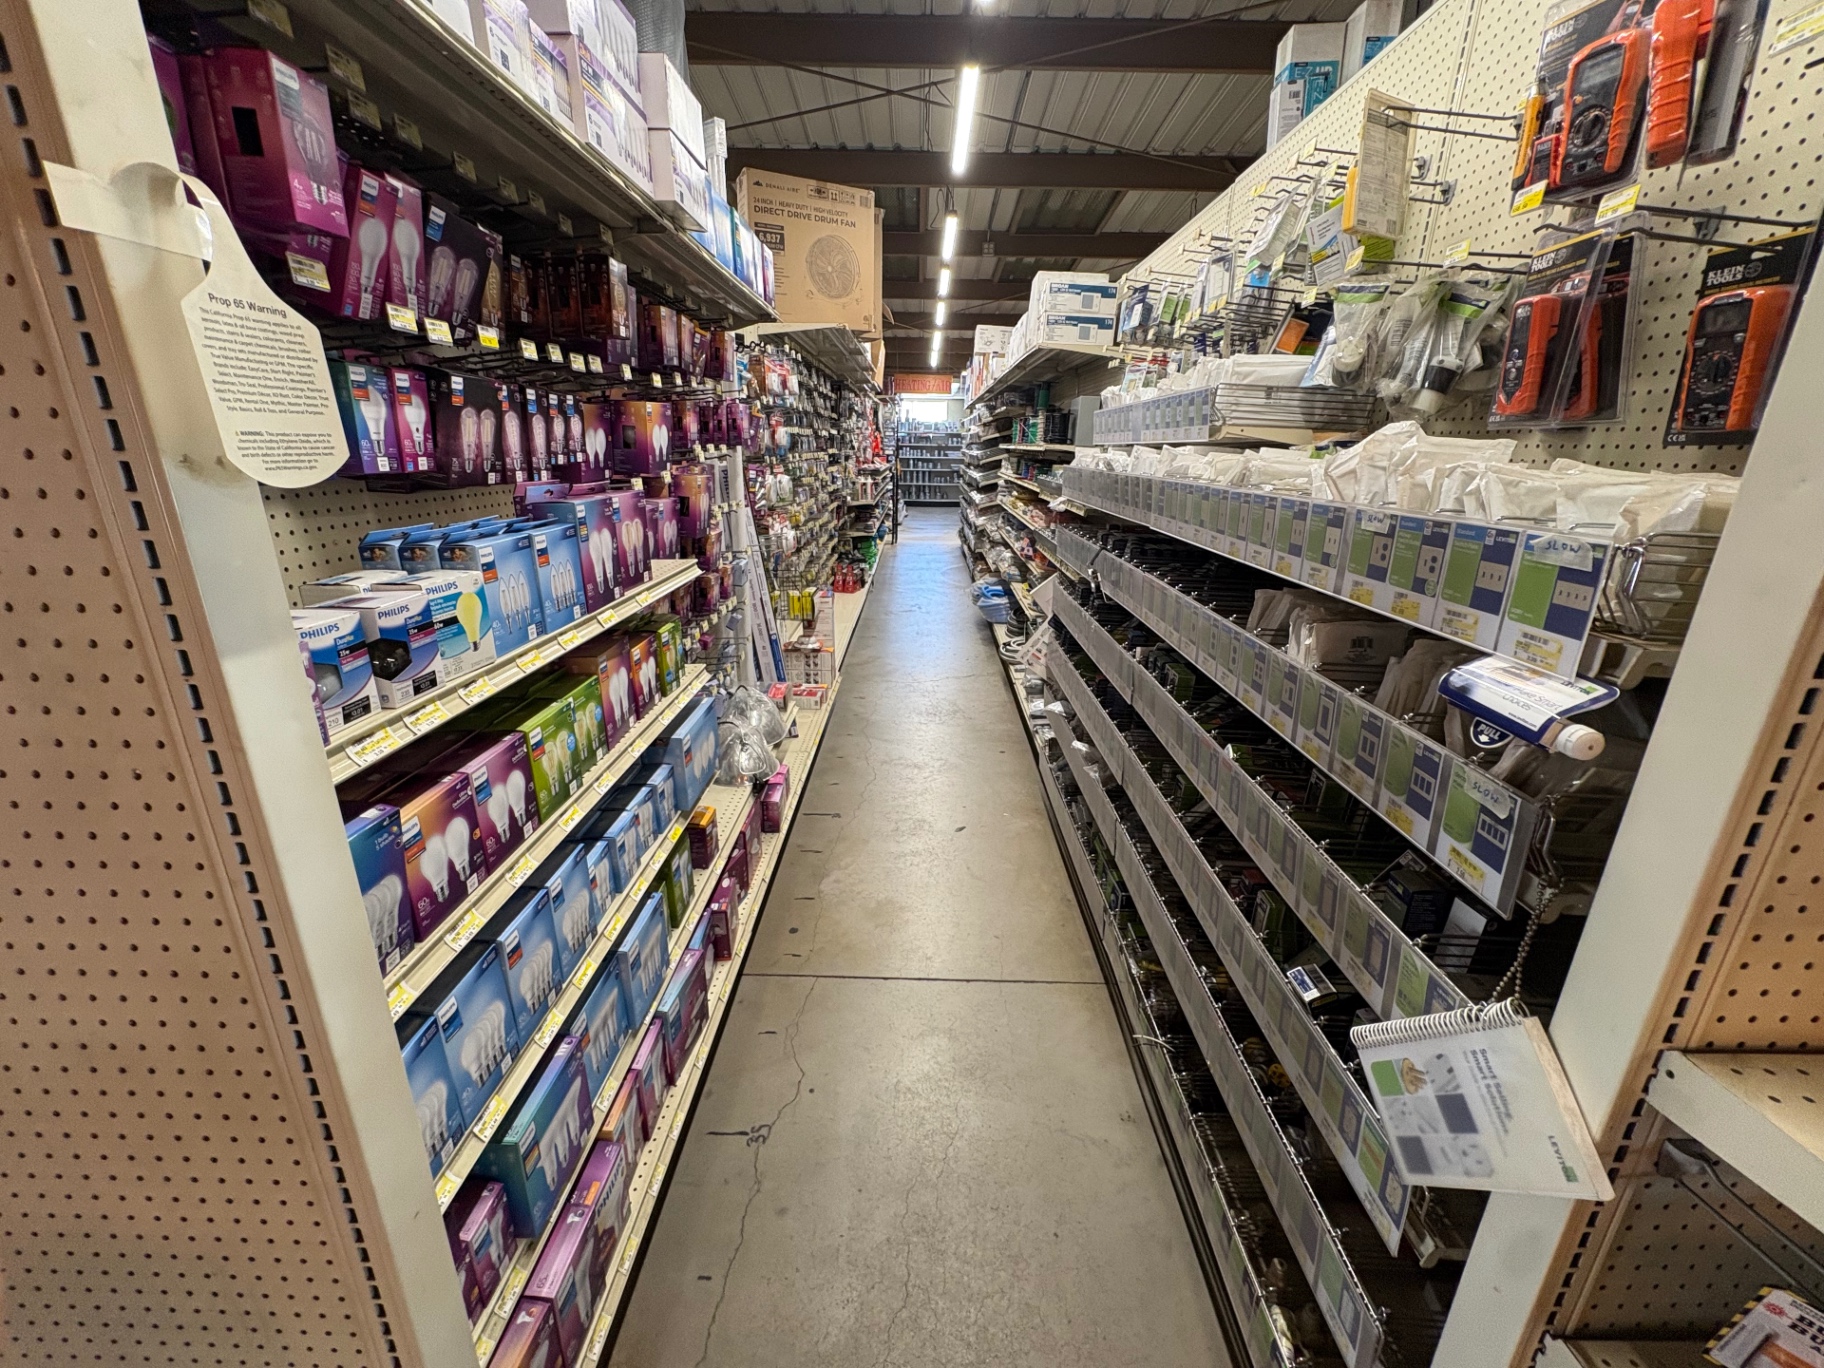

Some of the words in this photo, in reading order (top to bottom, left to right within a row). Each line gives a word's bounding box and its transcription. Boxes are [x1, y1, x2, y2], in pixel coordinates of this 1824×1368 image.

[765, 182, 785, 191] DENALI
[753, 196, 760, 204] 24
[779, 200, 795, 209] HEAVY
[795, 202, 808, 211] DUTY
[825, 208, 848, 217] VELOCITY
[754, 205, 785, 217] DIRECT
[787, 210, 813, 221] DRIVE
[814, 214, 839, 226] DRUM
[840, 220, 856, 229] FAN
[759, 232, 781, 244] 6,937
[1532, 251, 1557, 264] KLEIN
[1531, 260, 1553, 273] TOOLS
[1707, 264, 1746, 279] KLEIN
[1706, 272, 1743, 286] TOOLS
[207, 292, 231, 309] Prop
[232, 298, 245, 310] 65
[246, 300, 287, 319] Warning
[895, 379, 950, 391] HEATING/AIR
[1456, 528, 1476, 536] Standard
[1545, 540, 1582, 554] SLOW
[425, 581, 459, 597] PHILIPS
[377, 604, 411, 620] PHILIPS
[300, 622, 341, 641] PHILIPS
[1534, 695, 1564, 711] Smart
[328, 717, 339, 728] 210
[1477, 723, 1502, 740] PULL
[402, 821, 419, 836] PHILIPS
[1479, 1048, 1497, 1080] Smart
[1470, 1049, 1488, 1081] Smart
[1484, 1080, 1509, 1134] Solutions
[1547, 1135, 1575, 1183] LEVITON
